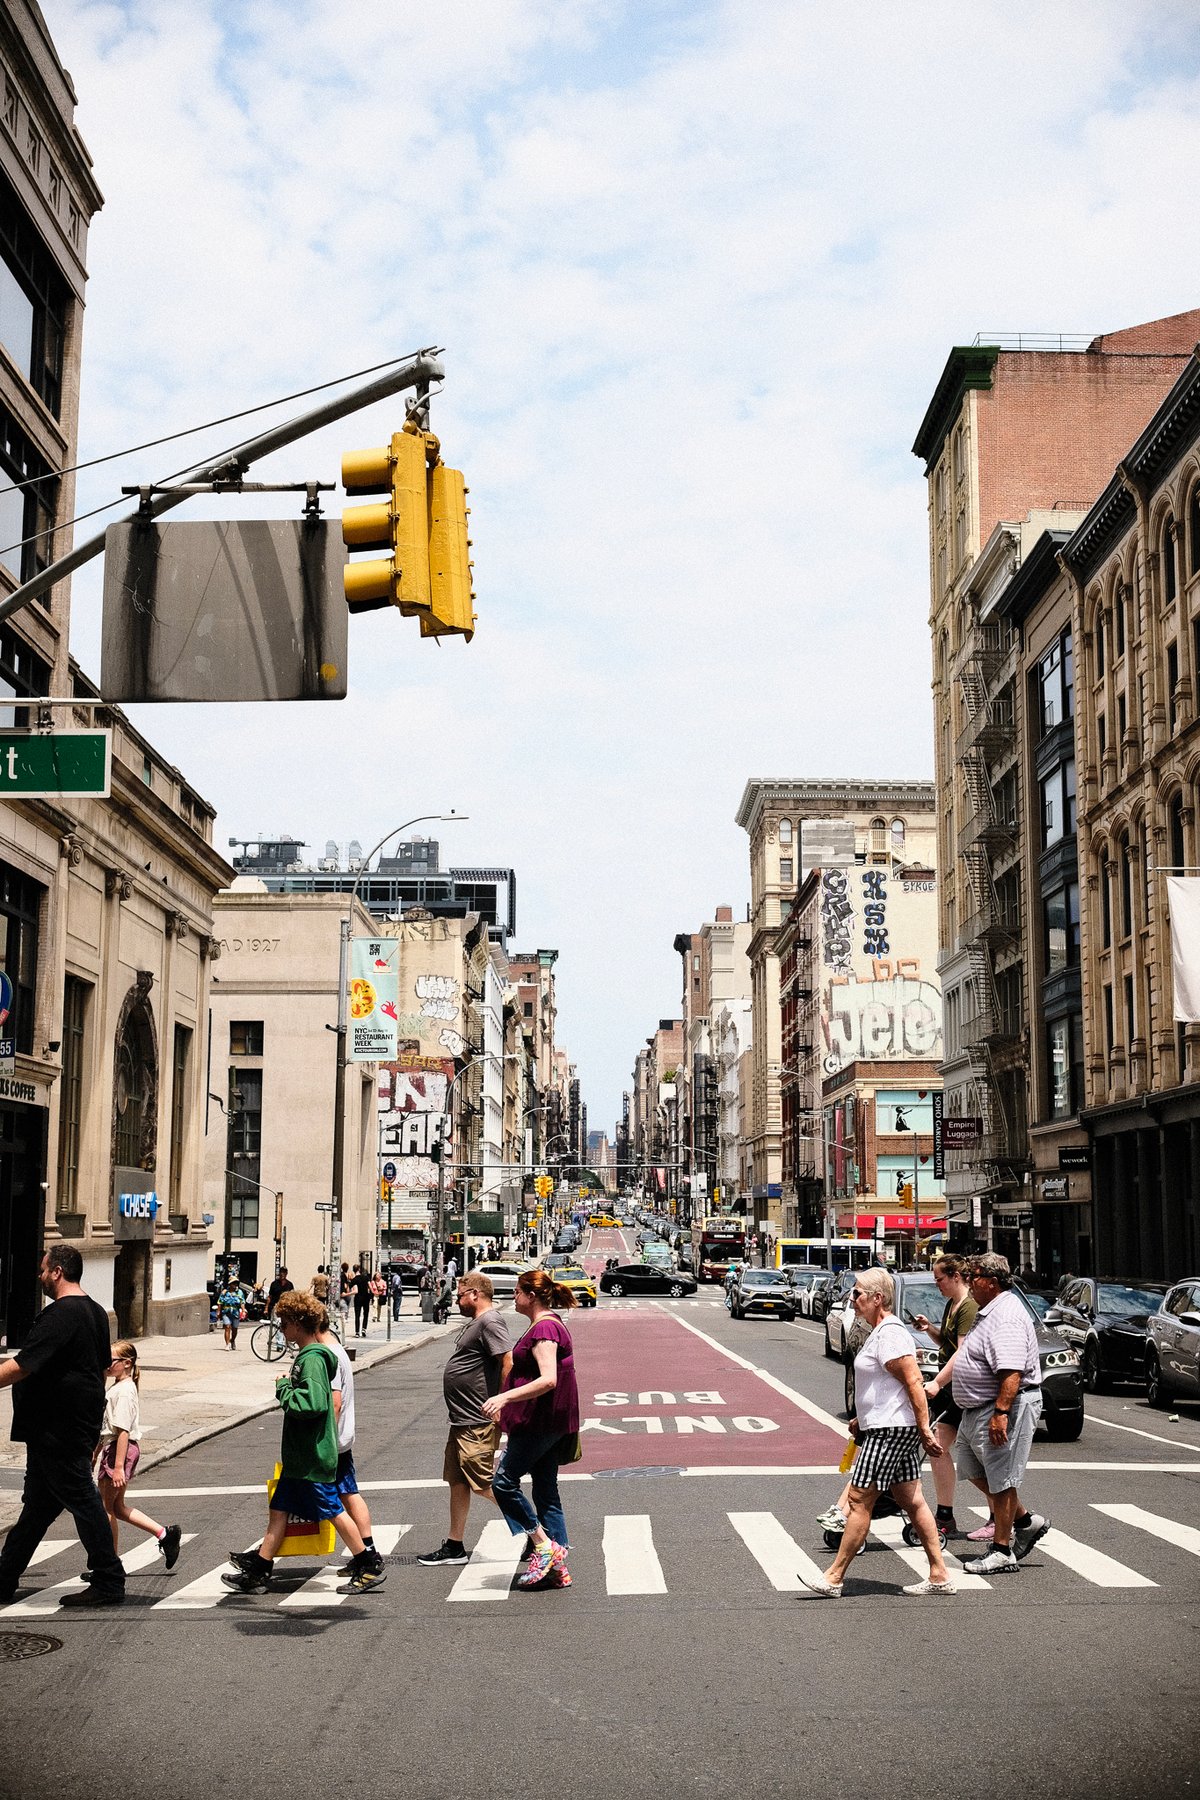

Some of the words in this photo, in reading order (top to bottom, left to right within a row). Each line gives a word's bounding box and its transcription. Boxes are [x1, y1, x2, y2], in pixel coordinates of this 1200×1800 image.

[0, 746, 19, 780] t
[247, 938, 281, 952] 1927
[10, 1080, 36, 1102] COFFEE
[934, 1095, 942, 1119] SOHO
[946, 1130, 979, 1139] Luggage
[948, 1121, 975, 1130] Empire
[935, 1119, 943, 1151] GARDEN
[1062, 1156, 1088, 1164] wework
[124, 1193, 150, 1218] CHASE
[593, 1391, 727, 1406] BUS
[578, 1416, 780, 1434] ONLY
